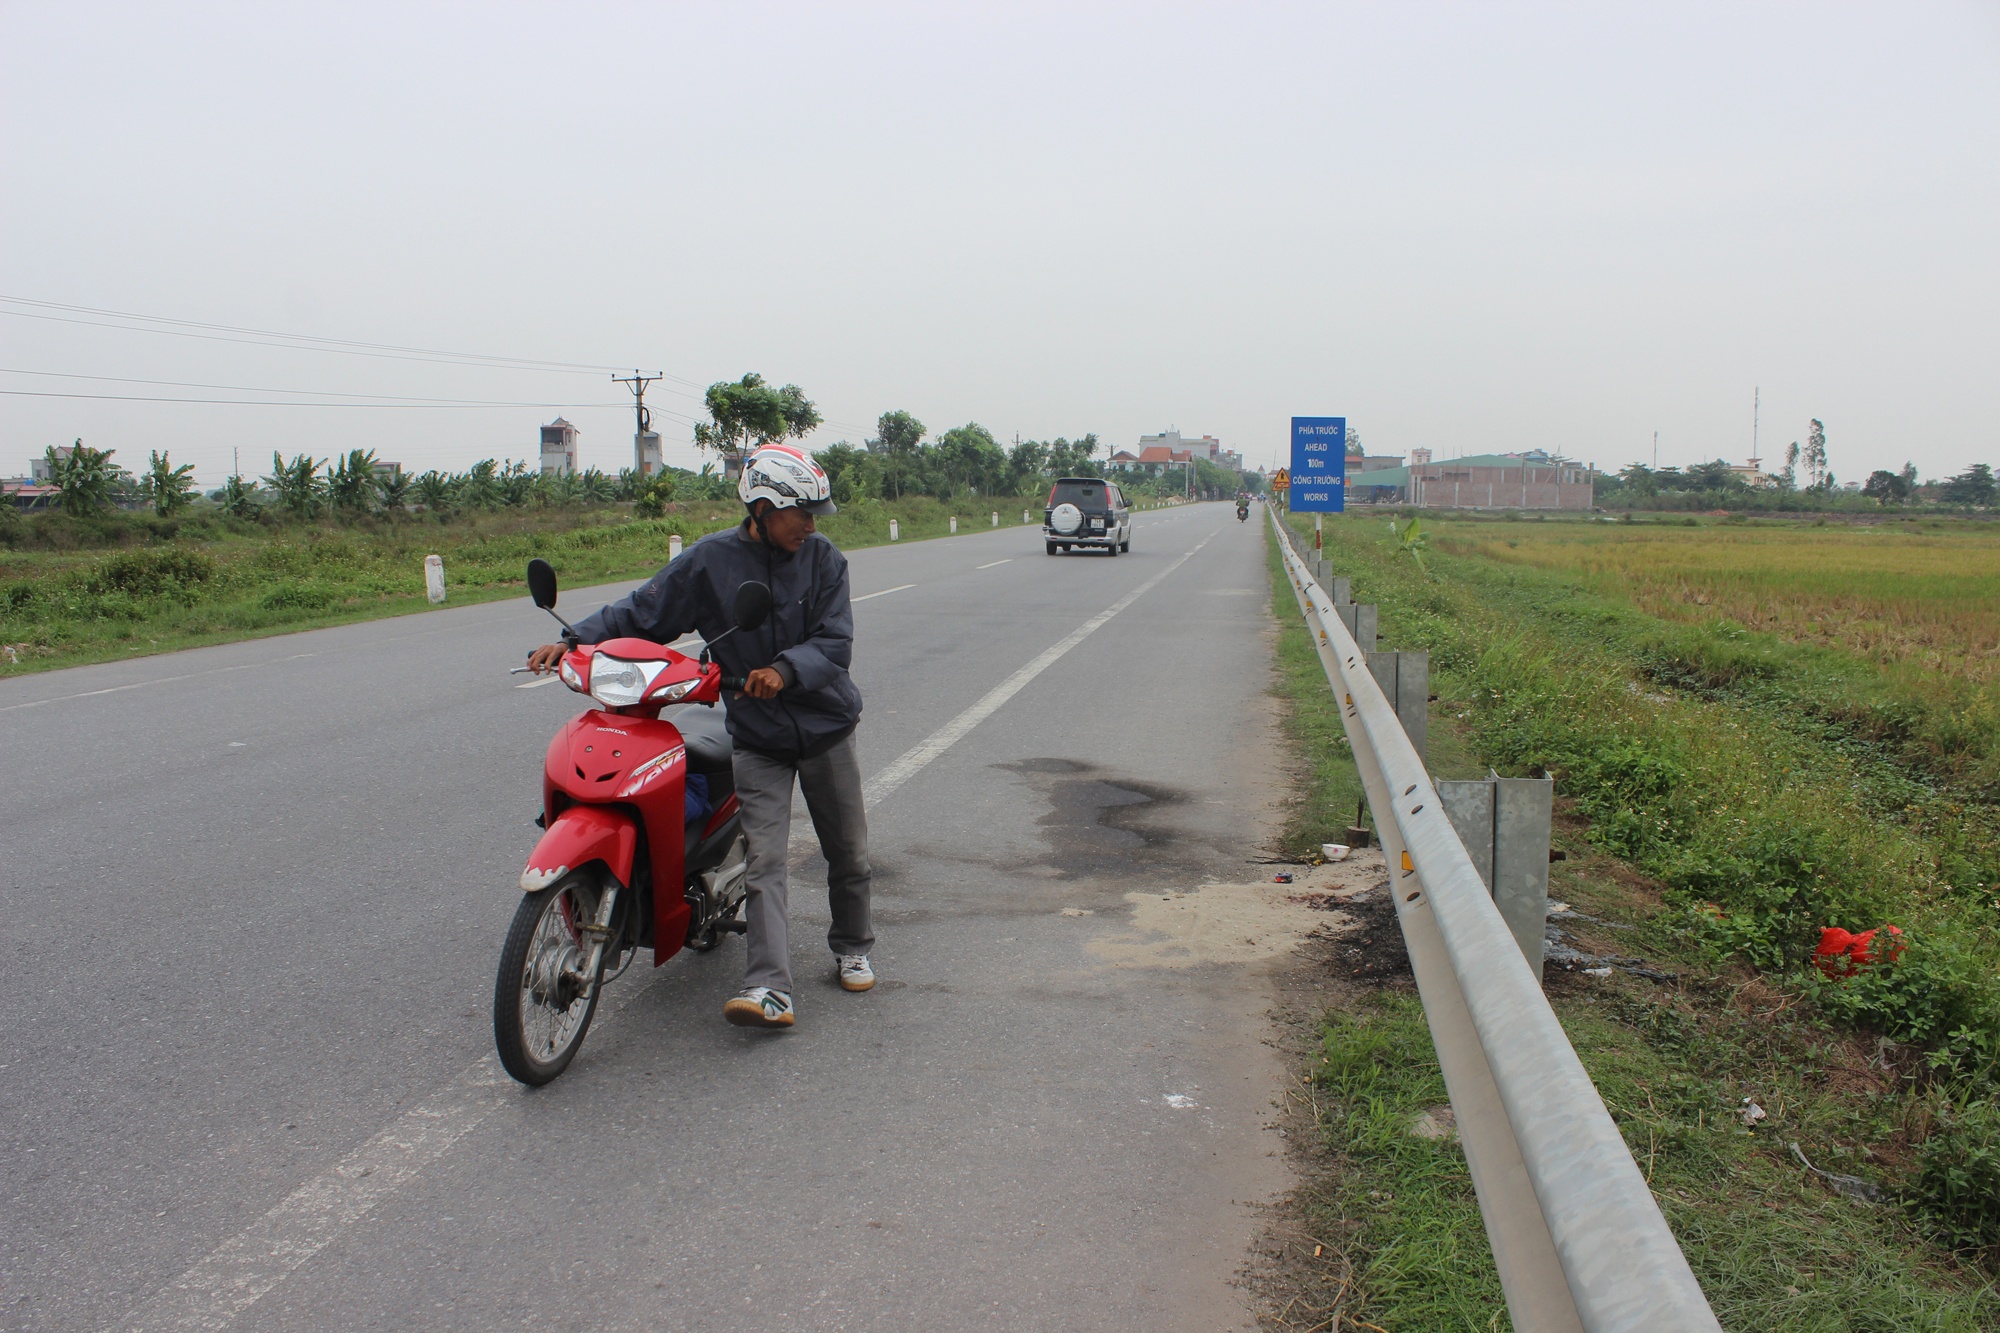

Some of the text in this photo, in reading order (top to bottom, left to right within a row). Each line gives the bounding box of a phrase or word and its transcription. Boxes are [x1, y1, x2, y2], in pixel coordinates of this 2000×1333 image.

[1298, 425, 1338, 434] PHÍA TRƯỚC
[1304, 443, 1327, 451] AHEAD
[1308, 459, 1324, 467] 100m
[1293, 475, 1340, 484] CÔNG TRƯỜNG
[1304, 493, 1328, 501] WORKS
[596, 727, 627, 735] HONDA
